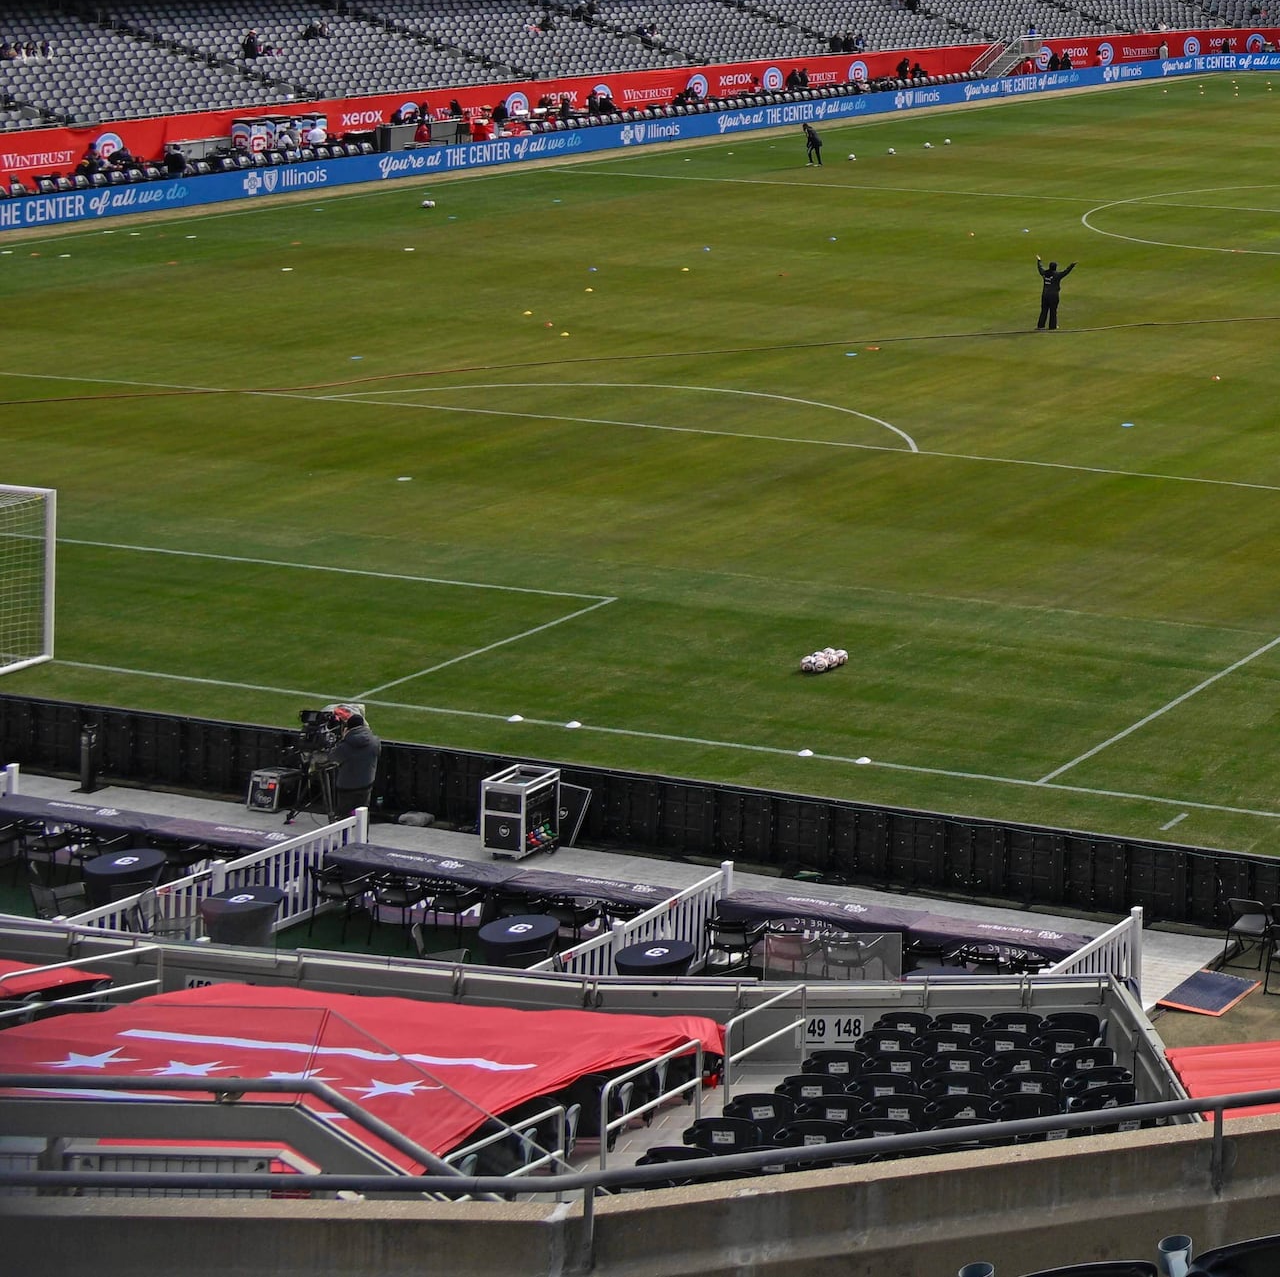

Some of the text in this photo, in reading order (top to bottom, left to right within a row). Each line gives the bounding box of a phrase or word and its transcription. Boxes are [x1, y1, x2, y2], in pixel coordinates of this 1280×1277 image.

[1062, 47, 1088, 58] xerox
[1120, 66, 1142, 77] Illinois
[1162, 59, 1183, 75] You're
[1184, 60, 1193, 69] at
[1194, 57, 1204, 69] THE
[1205, 56, 1236, 70] CENTER
[1239, 55, 1251, 70] of
[1253, 55, 1268, 66] all
[719, 73, 752, 86] xerox
[964, 72, 1080, 101] You're at THE CENTER of all we do
[623, 87, 674, 101] WINTRUST
[914, 89, 940, 103] Illinois
[342, 110, 383, 126] xerox
[718, 98, 867, 132] You're at THE CENTER of all we do
[648, 123, 680, 140] Illinois
[2, 151, 74, 169] WINTRUST
[379, 133, 582, 179] You're at THE CENTER of all we do
[282, 167, 328, 188] Illinois
[25, 181, 189, 225] CENTER of all we do
[834, 1018, 861, 1038] 148
